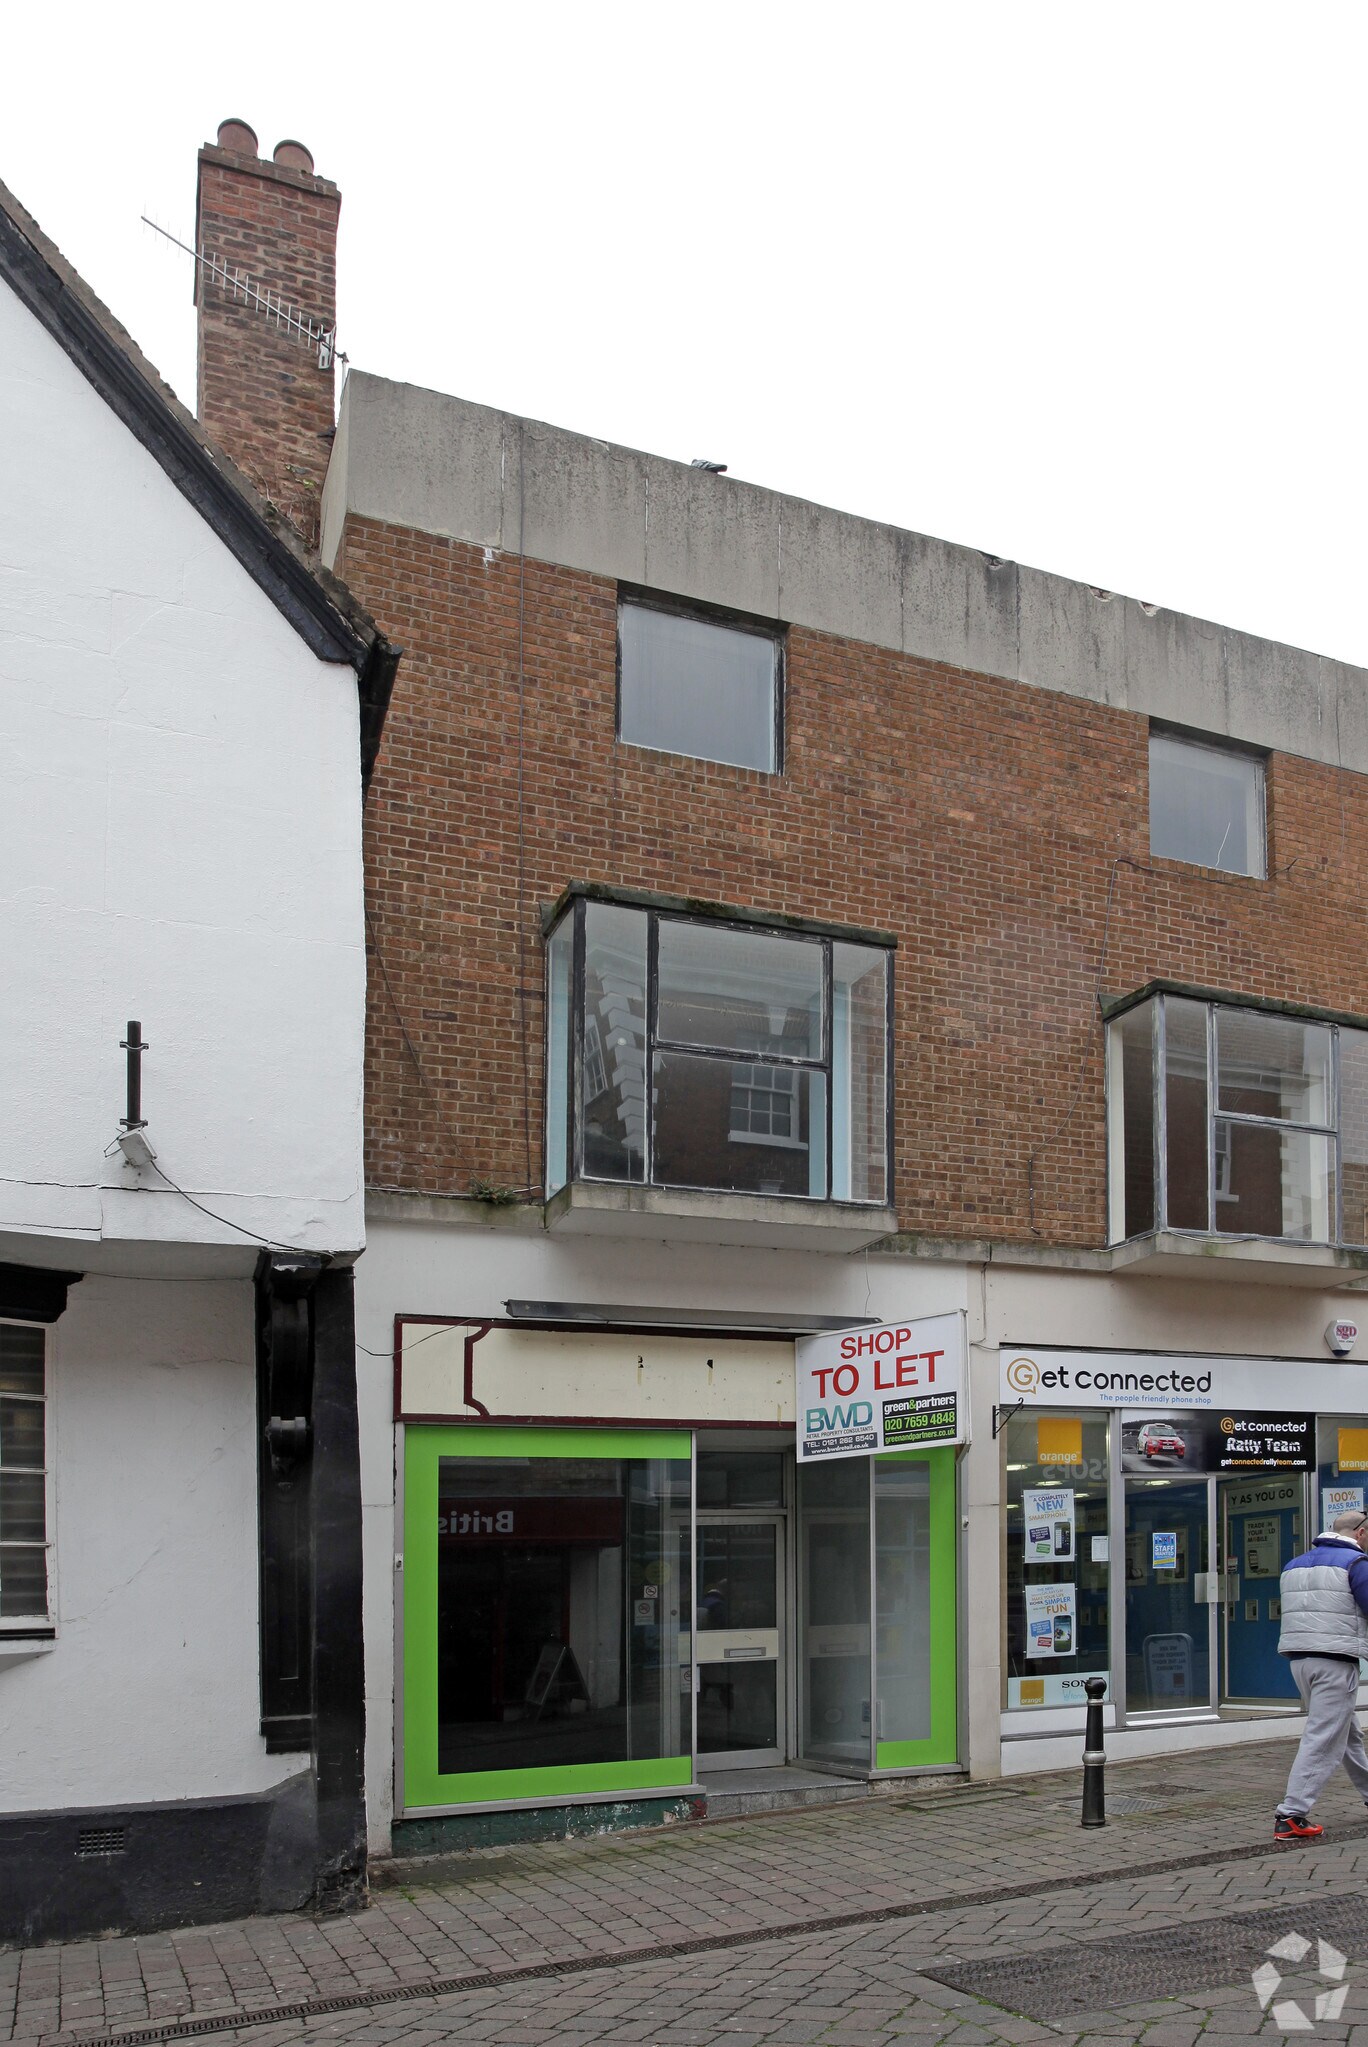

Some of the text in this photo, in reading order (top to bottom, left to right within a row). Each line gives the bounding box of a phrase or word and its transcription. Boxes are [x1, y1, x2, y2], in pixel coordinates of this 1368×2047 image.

[840, 1328, 911, 1359] SHOP
[811, 1350, 944, 1398] TO LET
[1007, 1358, 1211, 1394] Get connected
[884, 1395, 955, 1414] green&partners
[1115, 1395, 1139, 1403] people
[1141, 1395, 1170, 1404] friendly
[1171, 1396, 1193, 1404] phone
[806, 1401, 873, 1433] BWD
[885, 1412, 955, 1431] 020 7659 4848
[1220, 1416, 1306, 1434] Get connected
[821, 1430, 843, 1438] PROPERTY
[843, 1426, 874, 1435] CONSULTANTS
[884, 1429, 955, 1444] greenandpartners.co.uk
[811, 1442, 869, 1454] www.bwdretail.co.uk
[1226, 1437, 1301, 1454] Rally Team
[1040, 1452, 1077, 1463] orange
[1221, 1458, 1306, 1467] getconnectedrallyteam.com
[1240, 1494, 1252, 1504] AS
[1255, 1491, 1275, 1502] YOU
[1279, 1488, 1294, 1499] GO
[1330, 1491, 1356, 1503] 100%
[1036, 1499, 1064, 1512] NEW
[1328, 1500, 1361, 1510] PASS RATE
[1028, 1512, 1067, 1521] SMARTPHONE
[1044, 1597, 1071, 1605] SIMPLER
[1046, 1603, 1068, 1614] FUN
